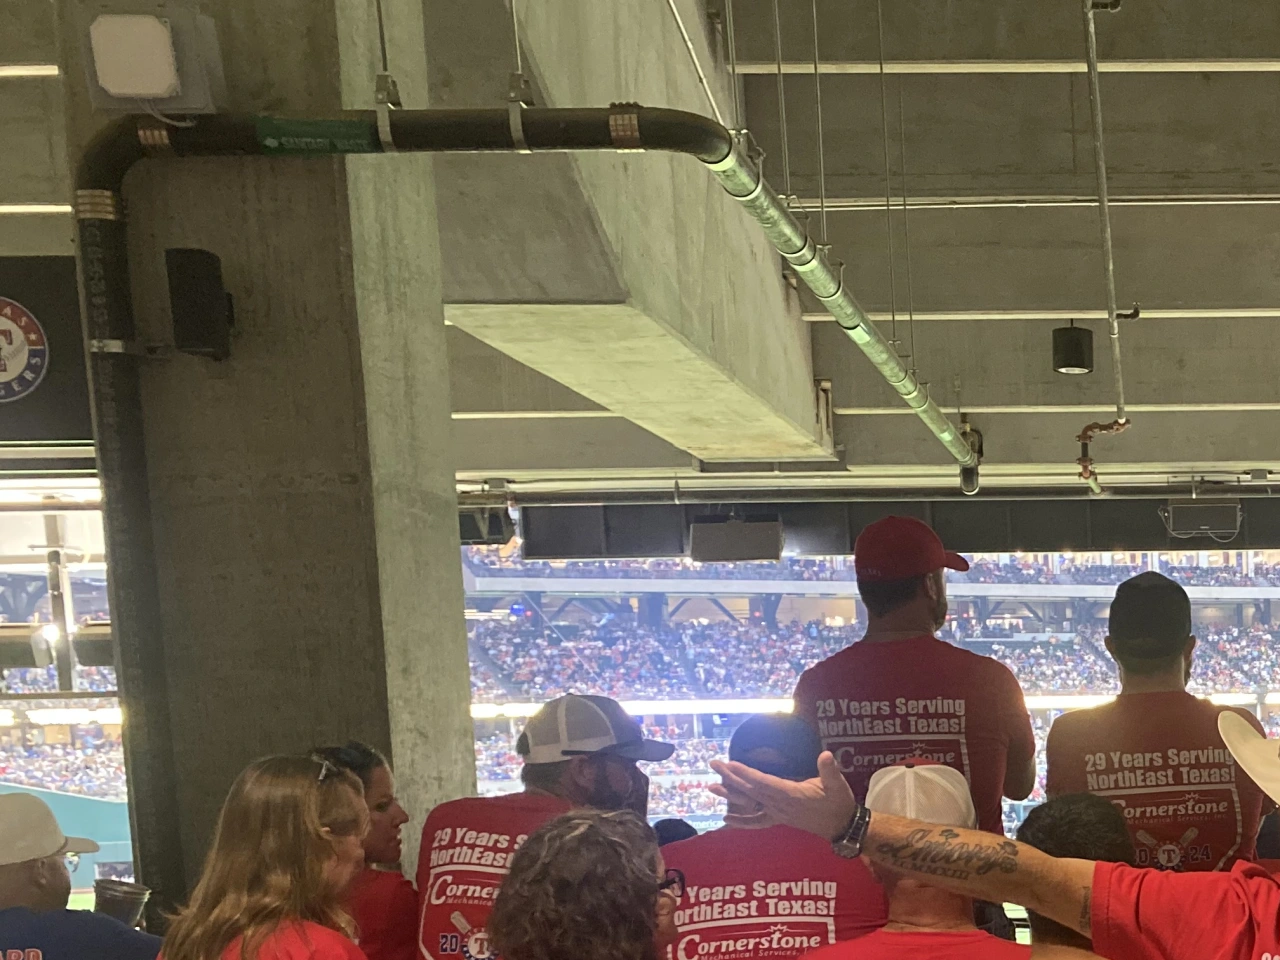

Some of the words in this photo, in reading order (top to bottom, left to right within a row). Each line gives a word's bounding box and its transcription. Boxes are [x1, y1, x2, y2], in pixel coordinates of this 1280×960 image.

[816, 698, 835, 717] 29
[839, 699, 890, 715] Years
[896, 696, 965, 716] Serving
[819, 718, 902, 736] NorthEast
[907, 716, 966, 733] Texas!
[1085, 753, 1106, 771] 29
[1110, 751, 1162, 768] Years
[1167, 746, 1234, 766] Serving
[1087, 769, 1174, 790] NorthEast
[1180, 765, 1236, 783] Texas!
[1111, 799, 1228, 819] ornerstone
[432, 828, 451, 847] 29
[455, 828, 510, 848] Years
[1189, 844, 1211, 863] 24
[687, 884, 746, 903] Years
[752, 878, 837, 898] Serving
[674, 900, 758, 926] orthEast
[765, 898, 835, 916] Texas!
[440, 933, 459, 953] 20
